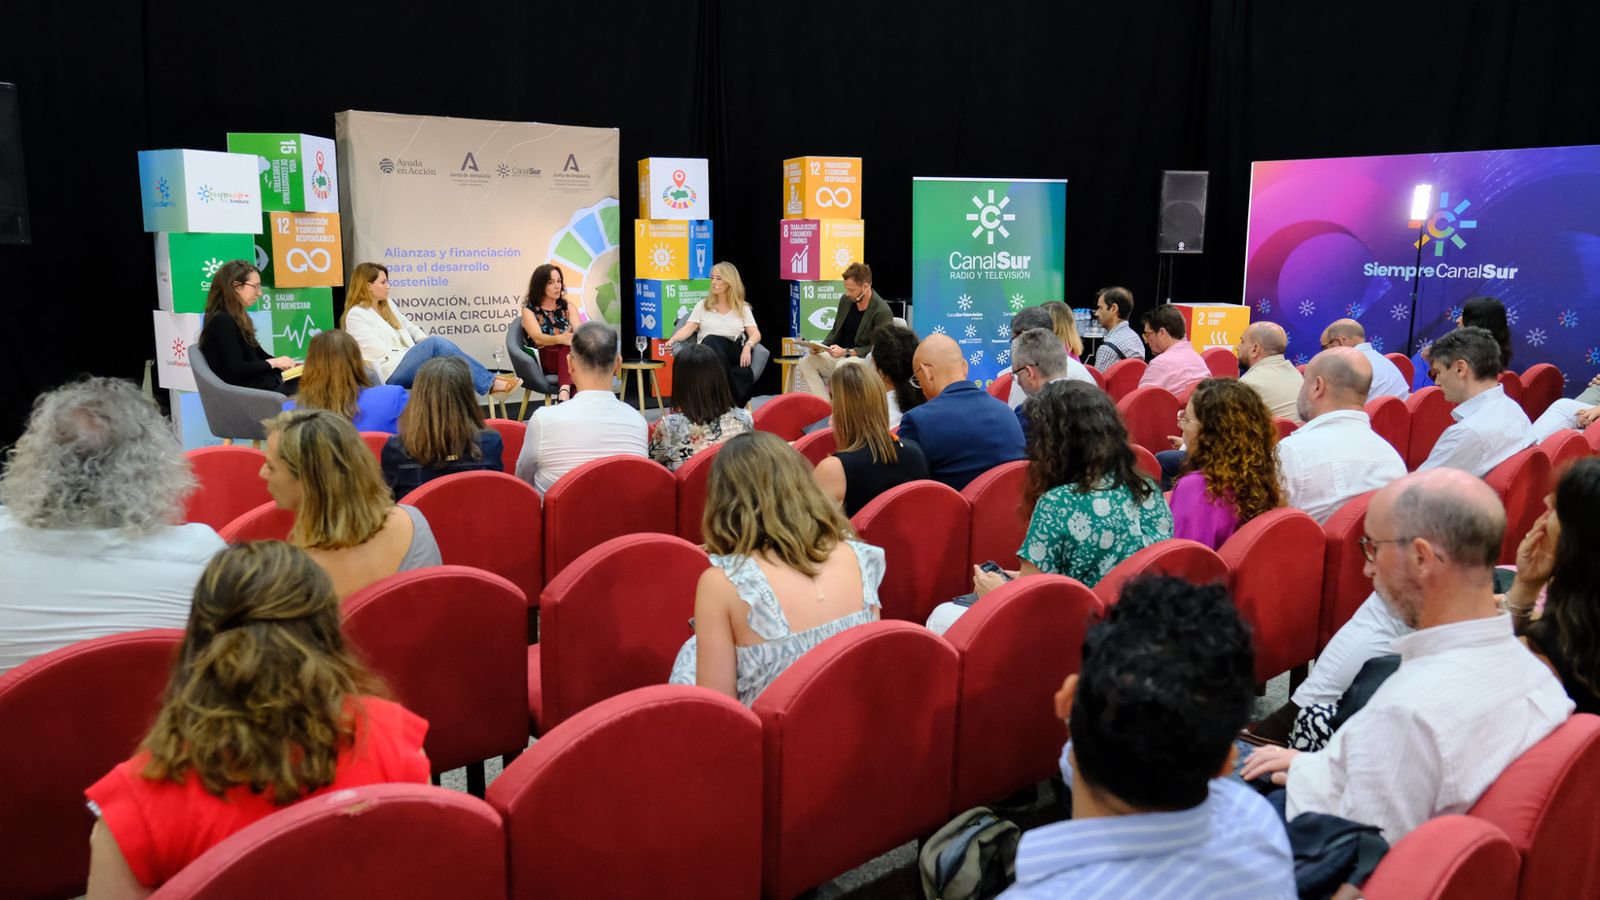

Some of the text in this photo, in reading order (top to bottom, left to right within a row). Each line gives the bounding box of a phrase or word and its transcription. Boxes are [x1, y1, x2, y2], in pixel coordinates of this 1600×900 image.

[280, 139, 297, 154] 15
[397, 158, 423, 168] Ayuda
[810, 161, 821, 176] 12
[407, 167, 437, 176] Acción
[276, 218, 290, 234] 12
[640, 223, 646, 238] 7
[783, 224, 789, 238] 8
[384, 247, 521, 260] Alianzas y financiación
[949, 251, 1031, 270] CanalSur
[386, 261, 490, 273] para el desarrollo
[388, 276, 449, 288] sostenible
[950, 270, 1031, 280] RADIO Y TELEVISIÓN
[665, 284, 676, 298] 15
[803, 285, 815, 299] 13
[262, 294, 271, 310] 3
[391, 294, 521, 308] NNOVACIÓN, CLIMA Y
[402, 308, 519, 322] ONOMÍA CIRCULAR
[1198, 312, 1205, 325] 2
[429, 324, 480, 336] AGENDA
[483, 322, 511, 334] GLO
[658, 344, 665, 357] 5
